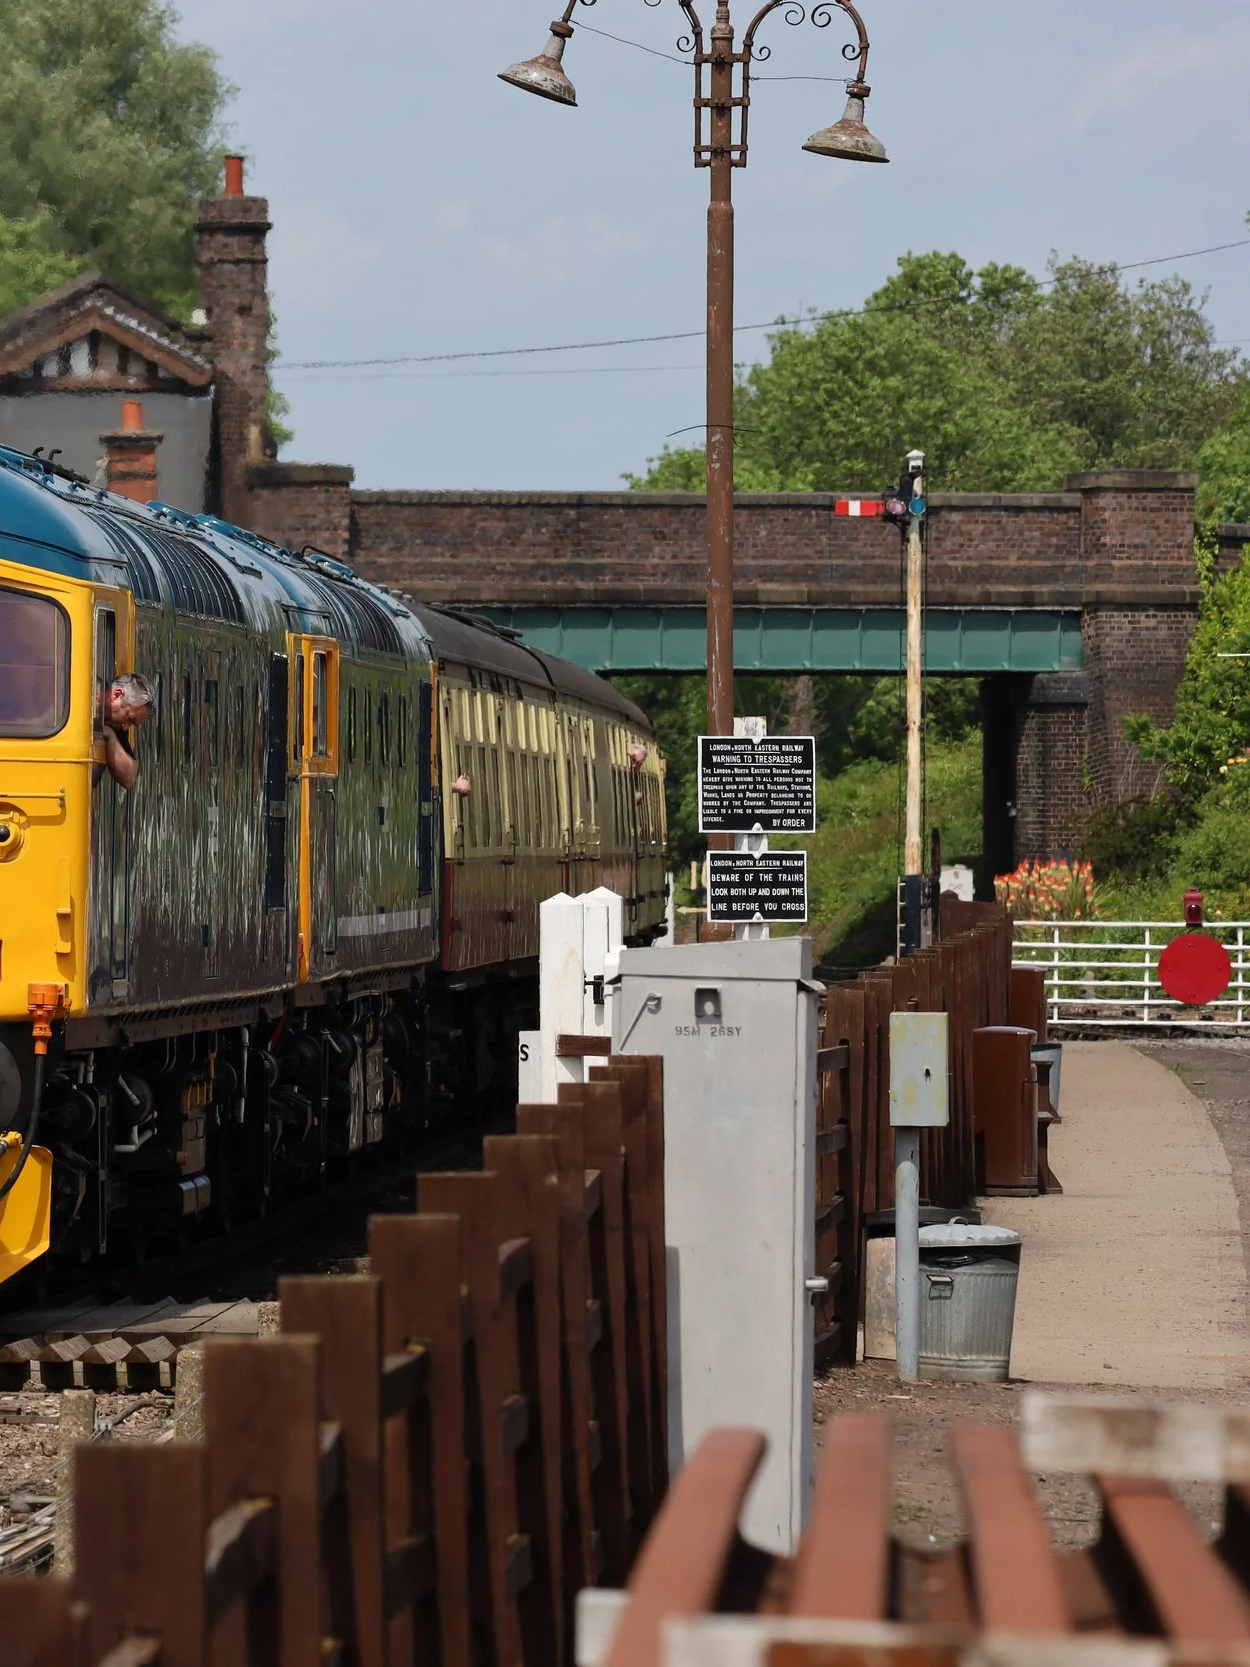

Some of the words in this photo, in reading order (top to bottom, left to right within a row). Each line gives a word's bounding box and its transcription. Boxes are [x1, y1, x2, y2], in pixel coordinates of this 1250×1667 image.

[709, 744, 731, 752] LONDON
[734, 744, 752, 752] NORTH
[754, 744, 780, 752] EASTERN
[781, 744, 805, 752] RAILWAY
[712, 755, 741, 763] WARNING
[743, 755, 753, 763] TO
[754, 755, 803, 763] TRESPASSERS
[737, 791, 744, 799] OR
[771, 791, 795, 799] BELONGING
[797, 791, 804, 799] TO
[806, 791, 812, 799] OR
[772, 818, 780, 827] BY
[782, 818, 806, 827] ORDER
[710, 859, 732, 867] LONDON
[735, 859, 754, 867] NORTH
[755, 859, 780, 867] EASTERN
[782, 859, 804, 867] RAILWAY
[711, 873, 740, 882] BEWARE
[744, 873, 754, 882] OF
[759, 873, 773, 882] THE
[778, 873, 804, 882] TRAINS
[711, 888, 728, 896] LOOK
[730, 888, 747, 896] BOTH
[748, 888, 757, 896] UP
[757, 888, 770, 896] AND
[772, 888, 790, 896] DOWN
[791, 888, 804, 896] THE
[711, 903, 728, 911] LINE
[732, 903, 760, 911] BEFORE
[763, 903, 777, 911] YOU
[781, 903, 805, 911] CROSS
[675, 1026, 700, 1036] 95M
[520, 1044, 529, 1062] S
